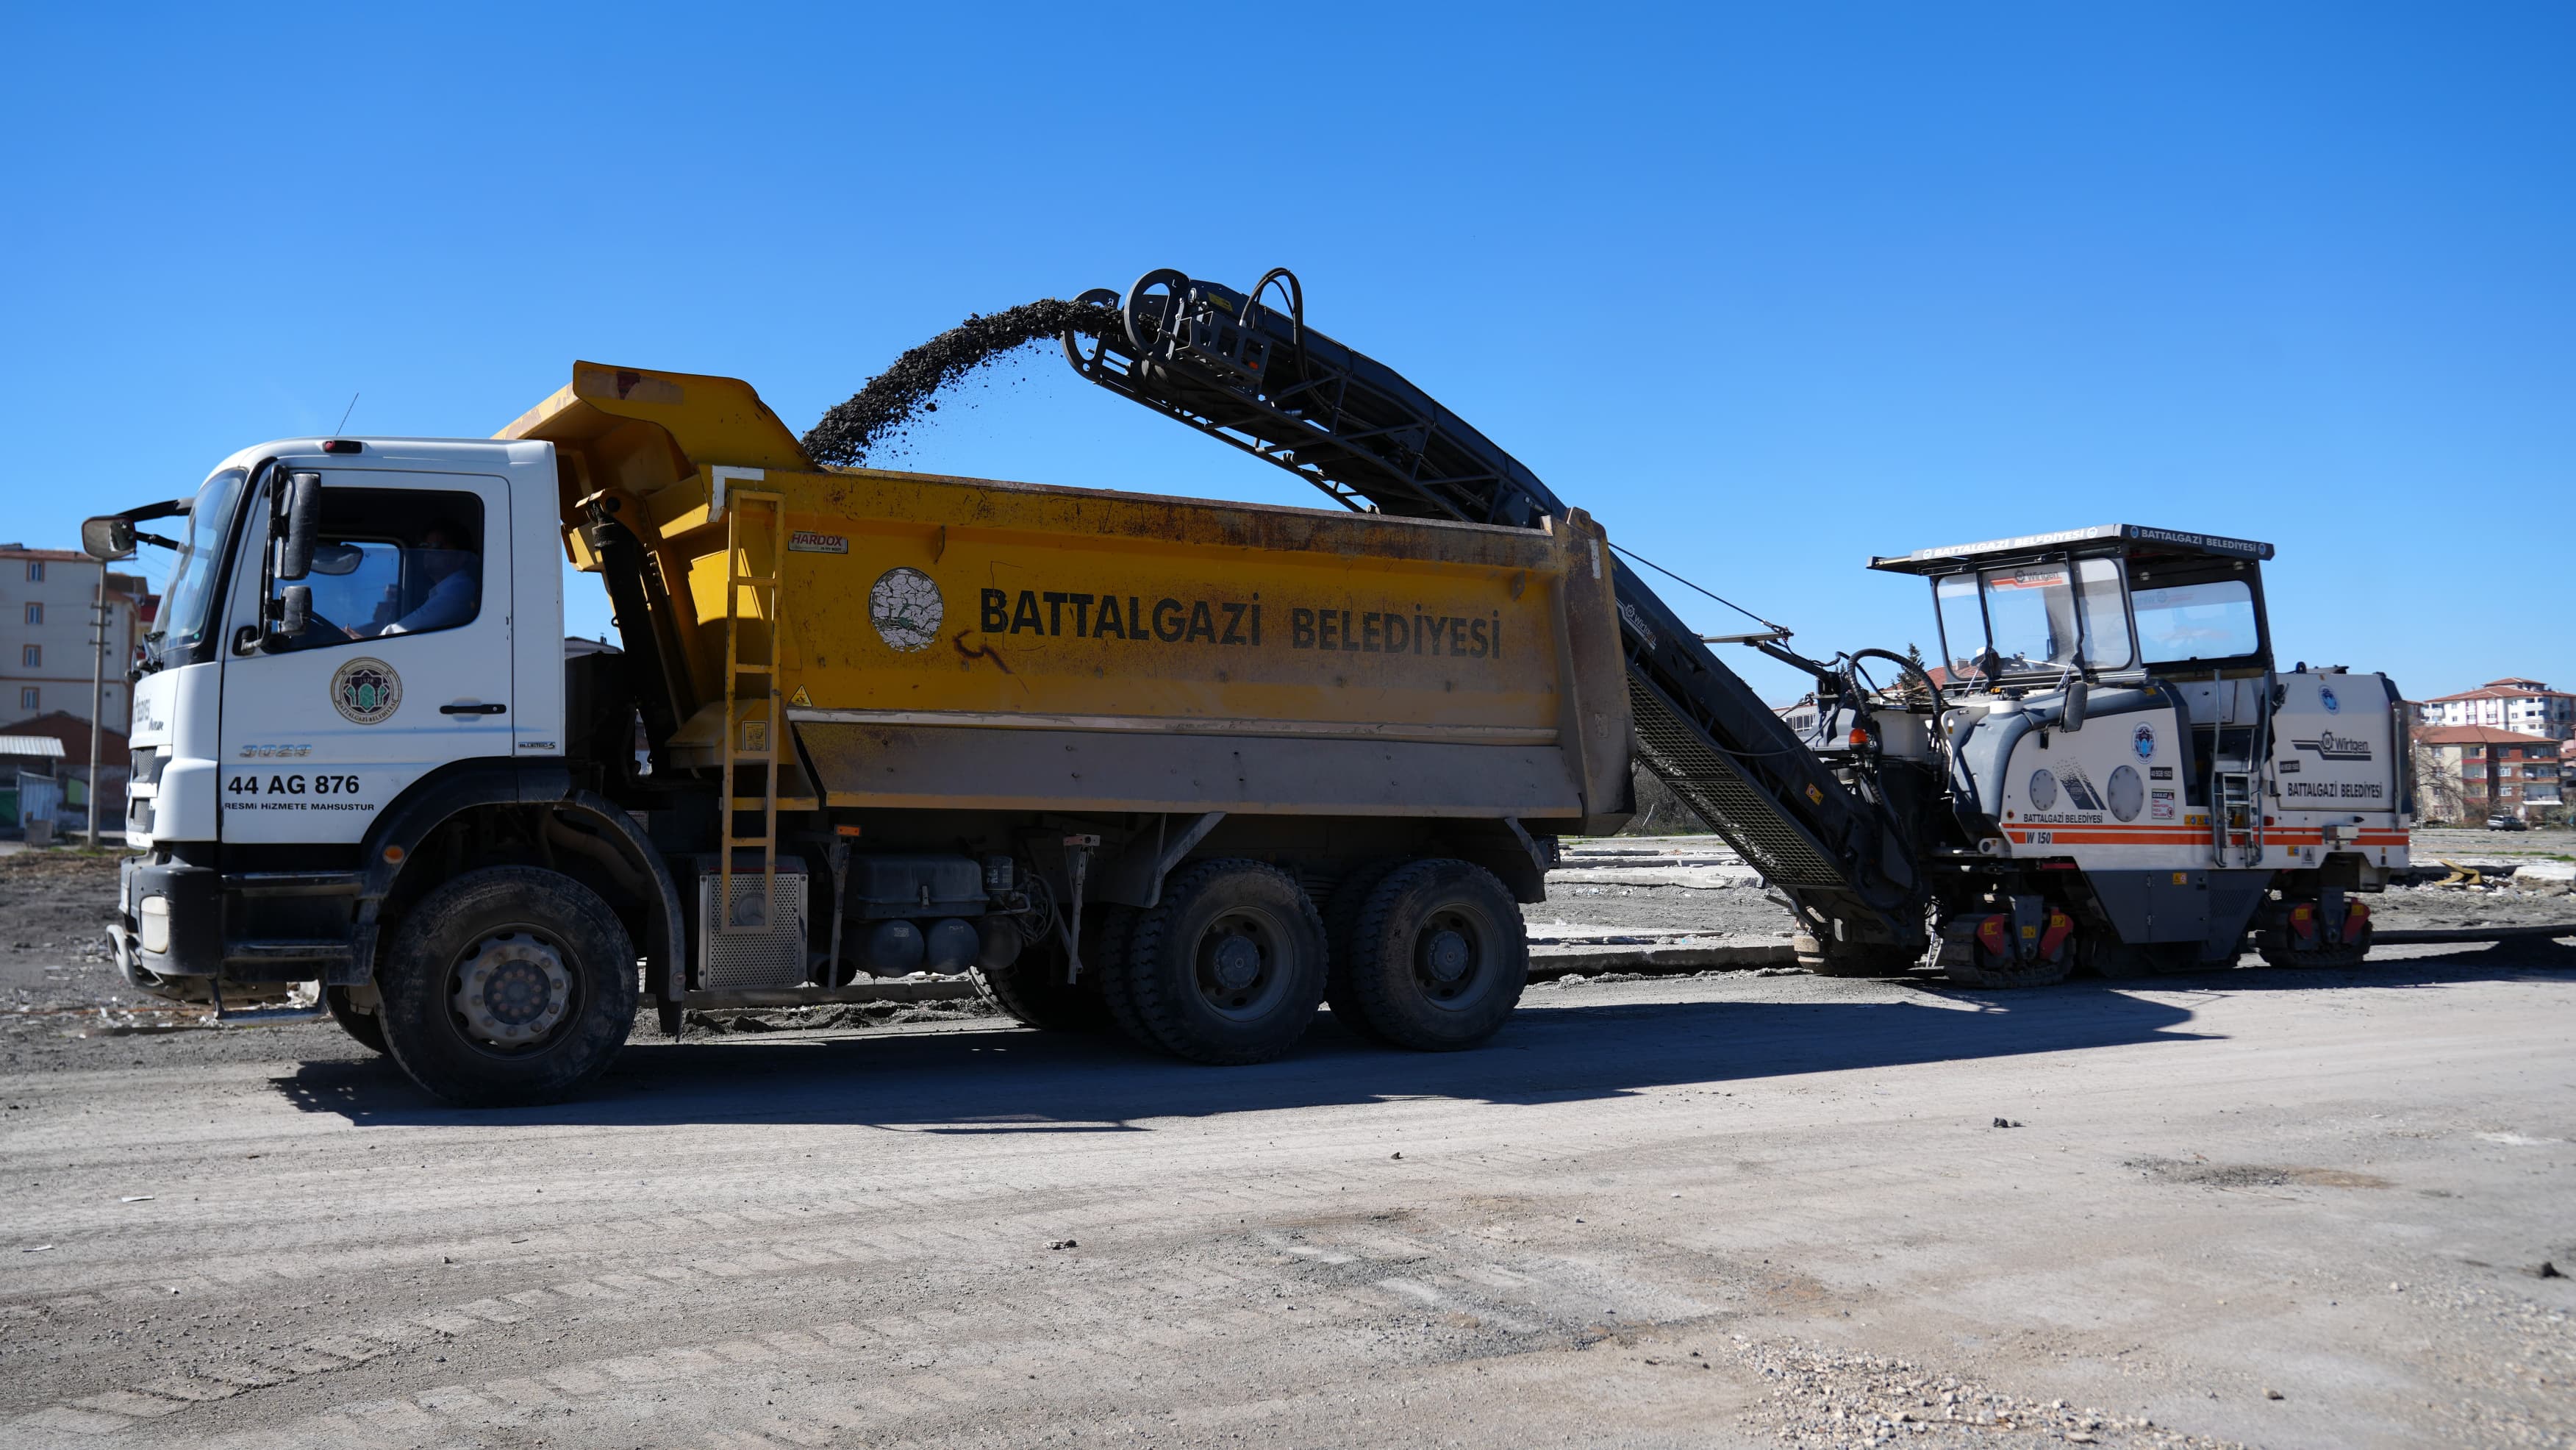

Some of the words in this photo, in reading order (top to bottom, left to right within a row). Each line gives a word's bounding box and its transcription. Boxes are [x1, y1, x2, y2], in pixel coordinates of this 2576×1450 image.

[791, 533, 842, 546] HARDOX
[2141, 529, 2202, 545] BATTALGAZİ
[2206, 538, 2256, 552] BELEDİYESİ
[2026, 570, 2058, 582] Wirtgen
[981, 588, 1261, 646] BATTALGAZİ
[1292, 603, 1500, 659] BELEDİYESİ
[2334, 738, 2369, 754] Wirtgen
[228, 776, 259, 794] 44
[267, 775, 305, 794] AG
[315, 775, 359, 794] 876
[2288, 780, 2337, 797] BATTALGAZİ
[2341, 781, 2383, 799] BELEDİYESİ
[311, 803, 375, 811] MAHSUSTUR
[2024, 812, 2064, 823] BATTALGAZİ
[2065, 812, 2103, 824] BELEDİYESİ
[2026, 832, 2035, 844] W
[2037, 832, 2051, 844] 150
